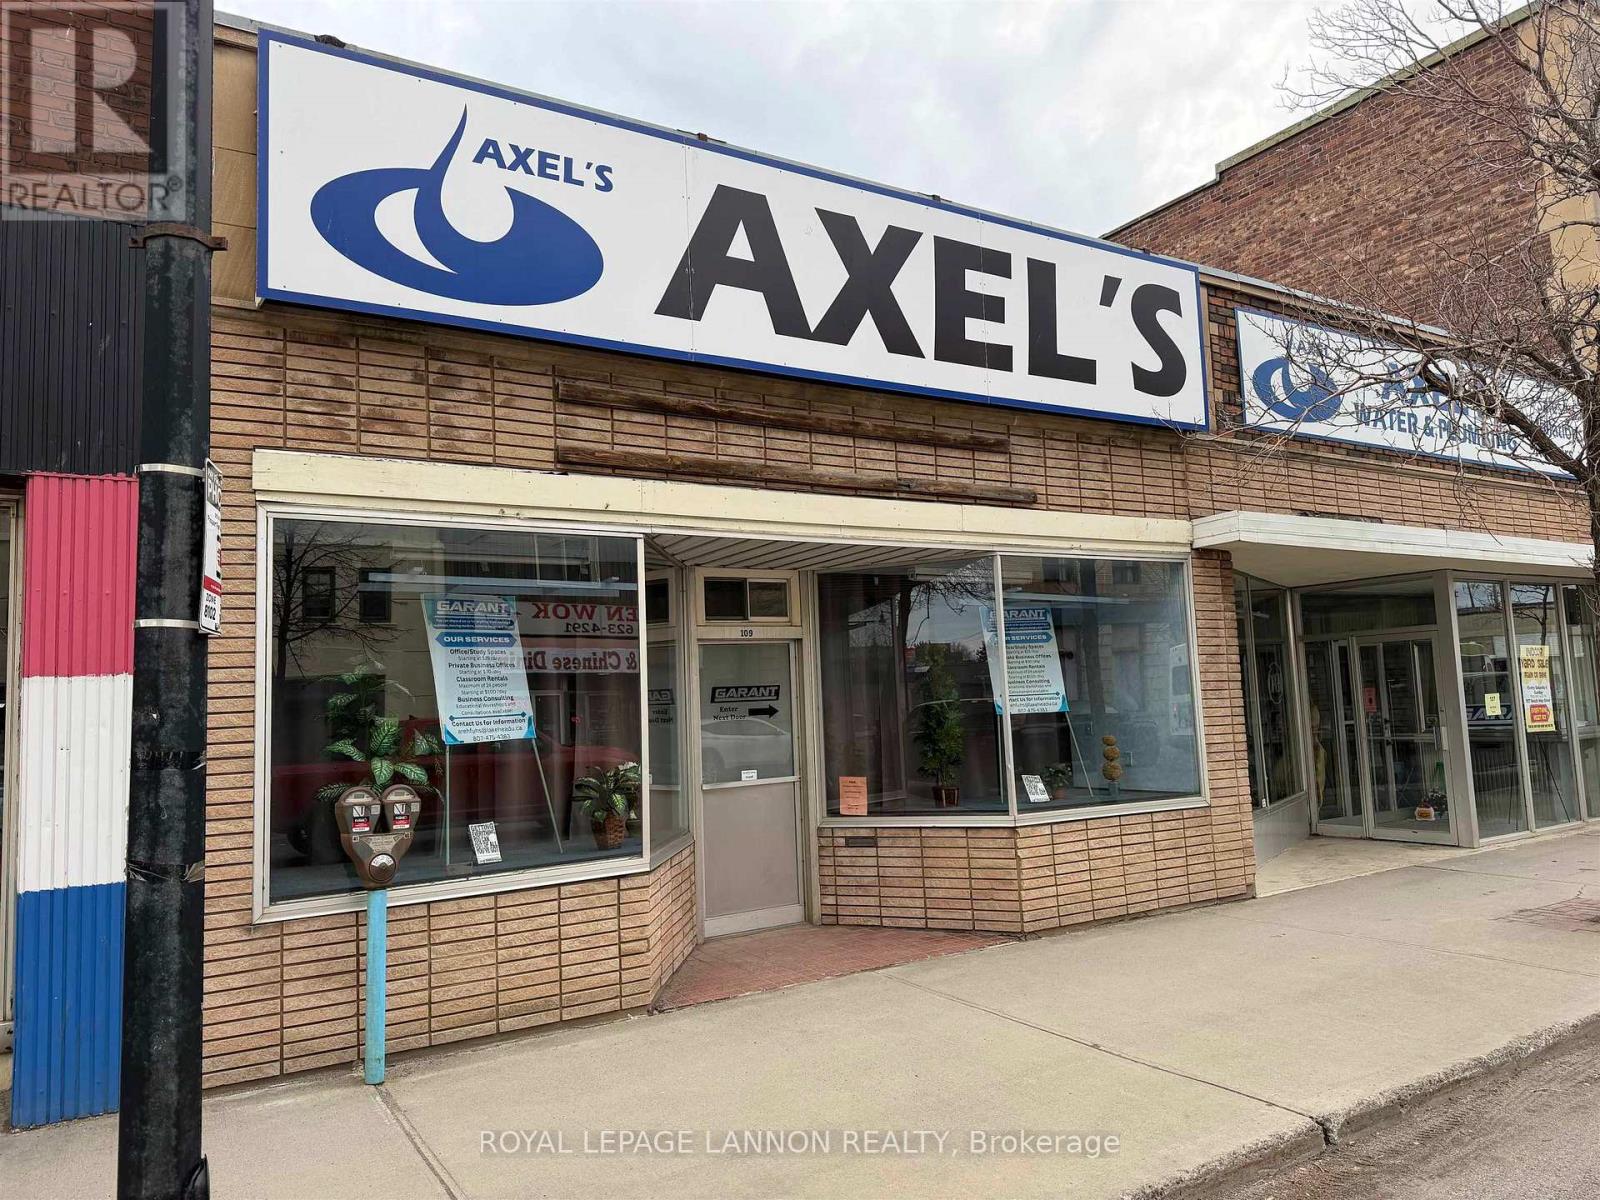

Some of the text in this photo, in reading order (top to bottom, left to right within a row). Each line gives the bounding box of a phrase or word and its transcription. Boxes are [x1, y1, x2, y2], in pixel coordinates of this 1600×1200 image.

[472, 138, 613, 192] AXEL'S
[654, 183, 1187, 397] AXEL'S
[436, 600, 510, 613] GARANT
[740, 629, 753, 637] 109
[465, 636, 510, 644] SERVICES
[715, 686, 778, 698] GARANT
[483, 695, 514, 703] Consulting
[452, 720, 475, 728] Contact
[492, 718, 526, 726] Information
